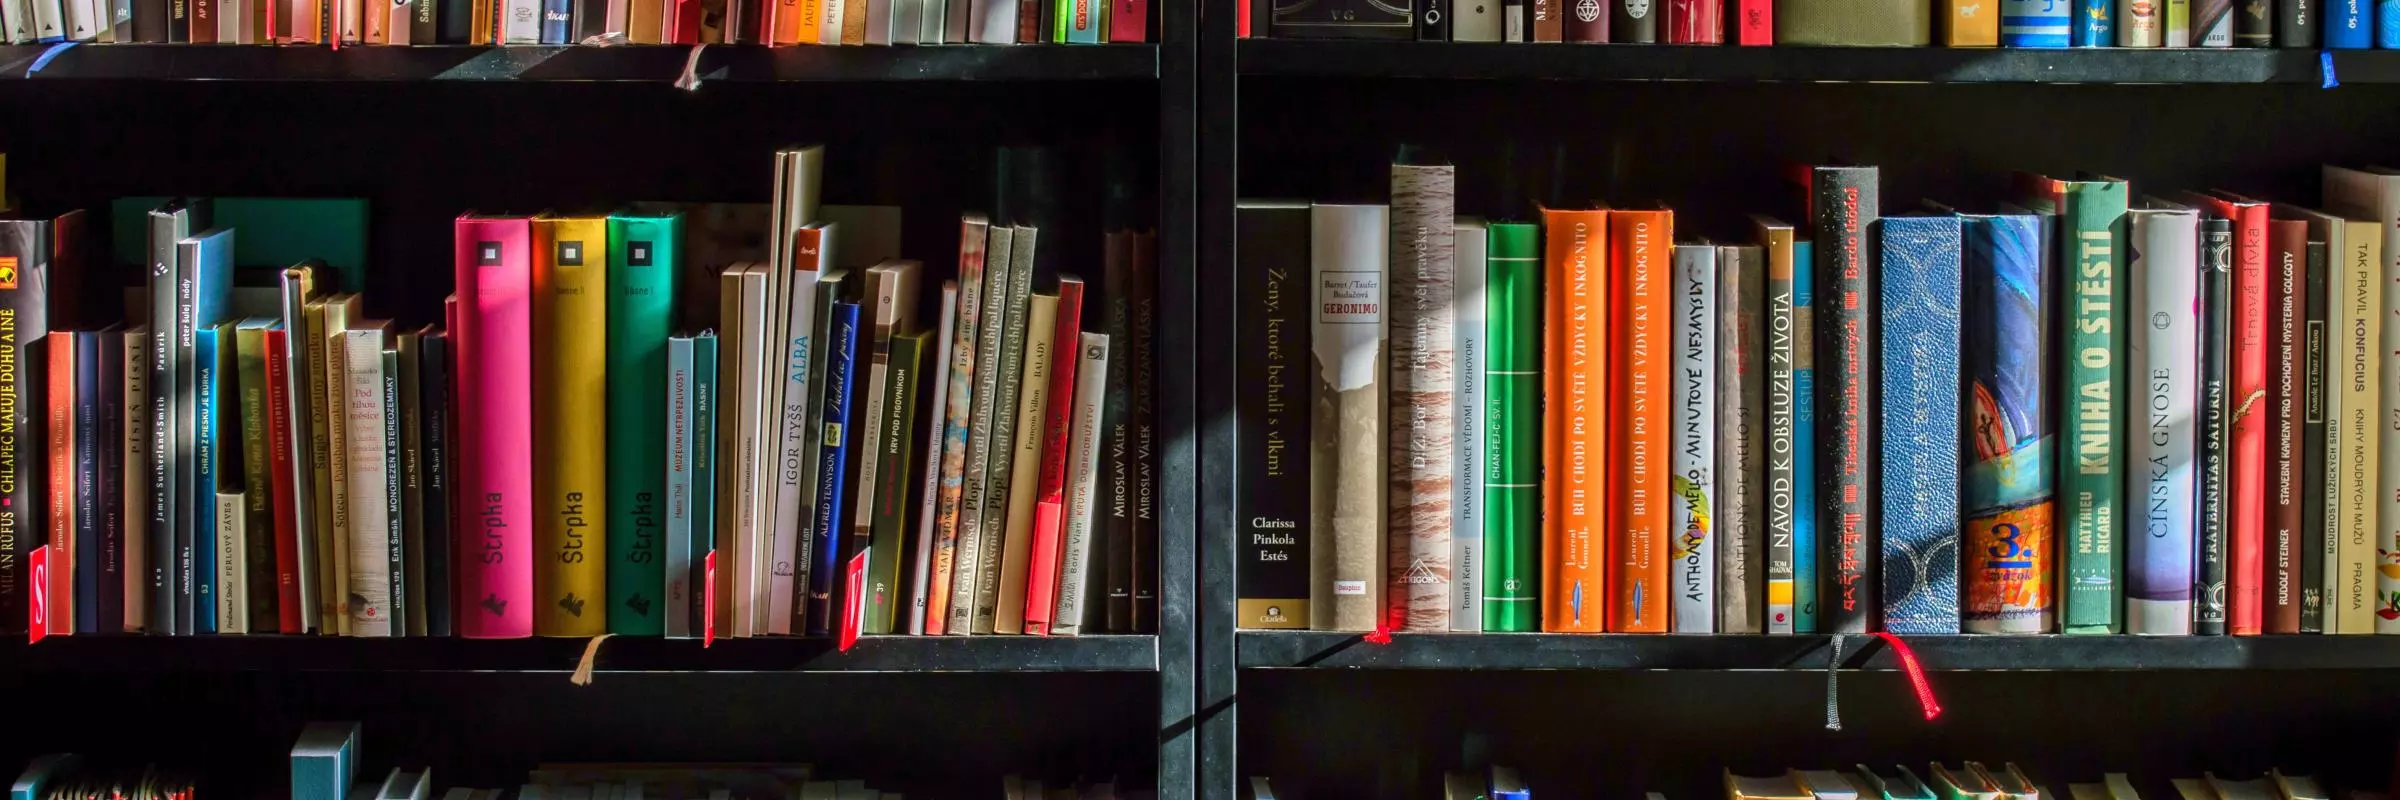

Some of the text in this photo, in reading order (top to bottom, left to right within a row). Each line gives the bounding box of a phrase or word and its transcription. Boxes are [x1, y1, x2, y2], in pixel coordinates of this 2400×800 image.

[2089, 22, 2109, 32] Argo
[1573, 222, 1588, 296] INKOGNITO
[1634, 222, 1649, 296] INKOGNITO
[180, 279, 191, 347] peter šulej nódy
[1323, 303, 1378, 314] GERONIMO
[2240, 227, 2261, 352] Trnová dívka
[0, 307, 14, 331] INÉ
[1267, 318, 1286, 360] ktoré
[1572, 302, 1588, 366] VŽDYCKY
[1632, 302, 1649, 366] VŽDYCKY
[1843, 186, 1861, 475] Tibetská kniha mrtvých Bardo thödol
[790, 335, 810, 385] ALBA
[1411, 226, 1430, 468] D. Z. Bor Tajemný svět pravěku
[2076, 230, 2112, 475] KNIHA O ŠTĚSTÍ
[2310, 329, 2320, 414] Anatole Le Ankou
[127, 344, 141, 454] PÍSEŇ PÍSNÍ
[355, 389, 373, 398] Pod
[891, 368, 906, 418] FIGOVNÍKOM
[1029, 339, 1045, 413] Villon BALADY
[1267, 365, 1286, 412] behali
[1572, 371, 1587, 412] SVĚTĚ
[1632, 371, 1648, 412] SVĚTĚ
[1799, 370, 1815, 422] SESTUP
[155, 331, 166, 522] James Pazúrik
[201, 397, 210, 408] JE
[201, 408, 210, 438] PIESKU
[892, 419, 902, 436] POD
[1267, 417, 1278, 425] s
[1572, 415, 1586, 434] PO
[1633, 415, 1647, 434] PO
[1769, 291, 1791, 549] NÁVOD K OBSLUZE ŽIVOTA
[2351, 242, 2368, 611] TAK PRAVIL KONFUCIUS KNIHY MOUDRÝCH MUŽŮ PRAGMA
[889, 437, 899, 454] KRV
[958, 310, 1001, 596] Ivan Wernisch Plop! Vyvrtil chlpal
[981, 309, 1024, 594] Ivan Wernisch Plop! Vyvrtil chlpal
[1112, 423, 1126, 458] VÁLEK
[1684, 277, 1705, 603] ANTHONY DE MELLO MINUTOVÉ NESMYSLY
[2147, 367, 2170, 539] ČÍNSKÁ GNOSE
[2279, 251, 2295, 605] RUDOLF STEINER STAVEBNÍ KAMENY PRO POCHOPENÍ MYSTERIA GOLGOTY
[0, 435, 14, 493] CHLAPEC
[200, 445, 210, 475] CHRÁM
[385, 376, 400, 562] Erik STEREOZEMIAKY
[784, 447, 800, 486] IGOR
[1137, 424, 1152, 520] MIROSLAV VÁLEK
[1267, 431, 1286, 476] vlkmi
[1461, 336, 1474, 610] Tomáš Keltner TRANSFORMACE VĚDOMÍ ROZHOVORY
[1571, 439, 1586, 484] CHODÍ
[1632, 439, 1647, 484] CHODÍ
[2205, 379, 2221, 564] FRATERNITAS SATURNI
[82, 470, 92, 497] Seifert
[819, 452, 836, 537] ALFRED TENNYSON
[1112, 459, 1126, 518] MIROSLAV
[1736, 422, 1751, 583] ANTHONY DE MELLO
[2326, 418, 2338, 554] MOUDROST LUŽICKÝCH SRBŮ
[55, 490, 65, 554] Jaroslav Seifert
[221, 501, 232, 531] ZÁVES
[479, 491, 508, 565] Štrpka
[556, 491, 589, 565] Štrpka
[624, 491, 659, 565] Štrpka
[941, 495, 955, 542] VIDMAR
[1071, 521, 1083, 544] Vian
[1252, 517, 1296, 529] Clarissa
[1253, 533, 1296, 545] Pinkola
[1988, 523, 2032, 558] 3.
[2079, 491, 2093, 554] MATTHIEU
[2096, 505, 2111, 554] RICARD
[1069, 549, 1081, 574] Boris
[1260, 549, 1289, 561] Estés
[1564, 528, 1578, 566] Laurent
[1577, 525, 1590, 570] Gounelle
[1625, 528, 1639, 566] Laurent
[1638, 525, 1652, 570] Gounelle
[876, 582, 885, 593] 39
